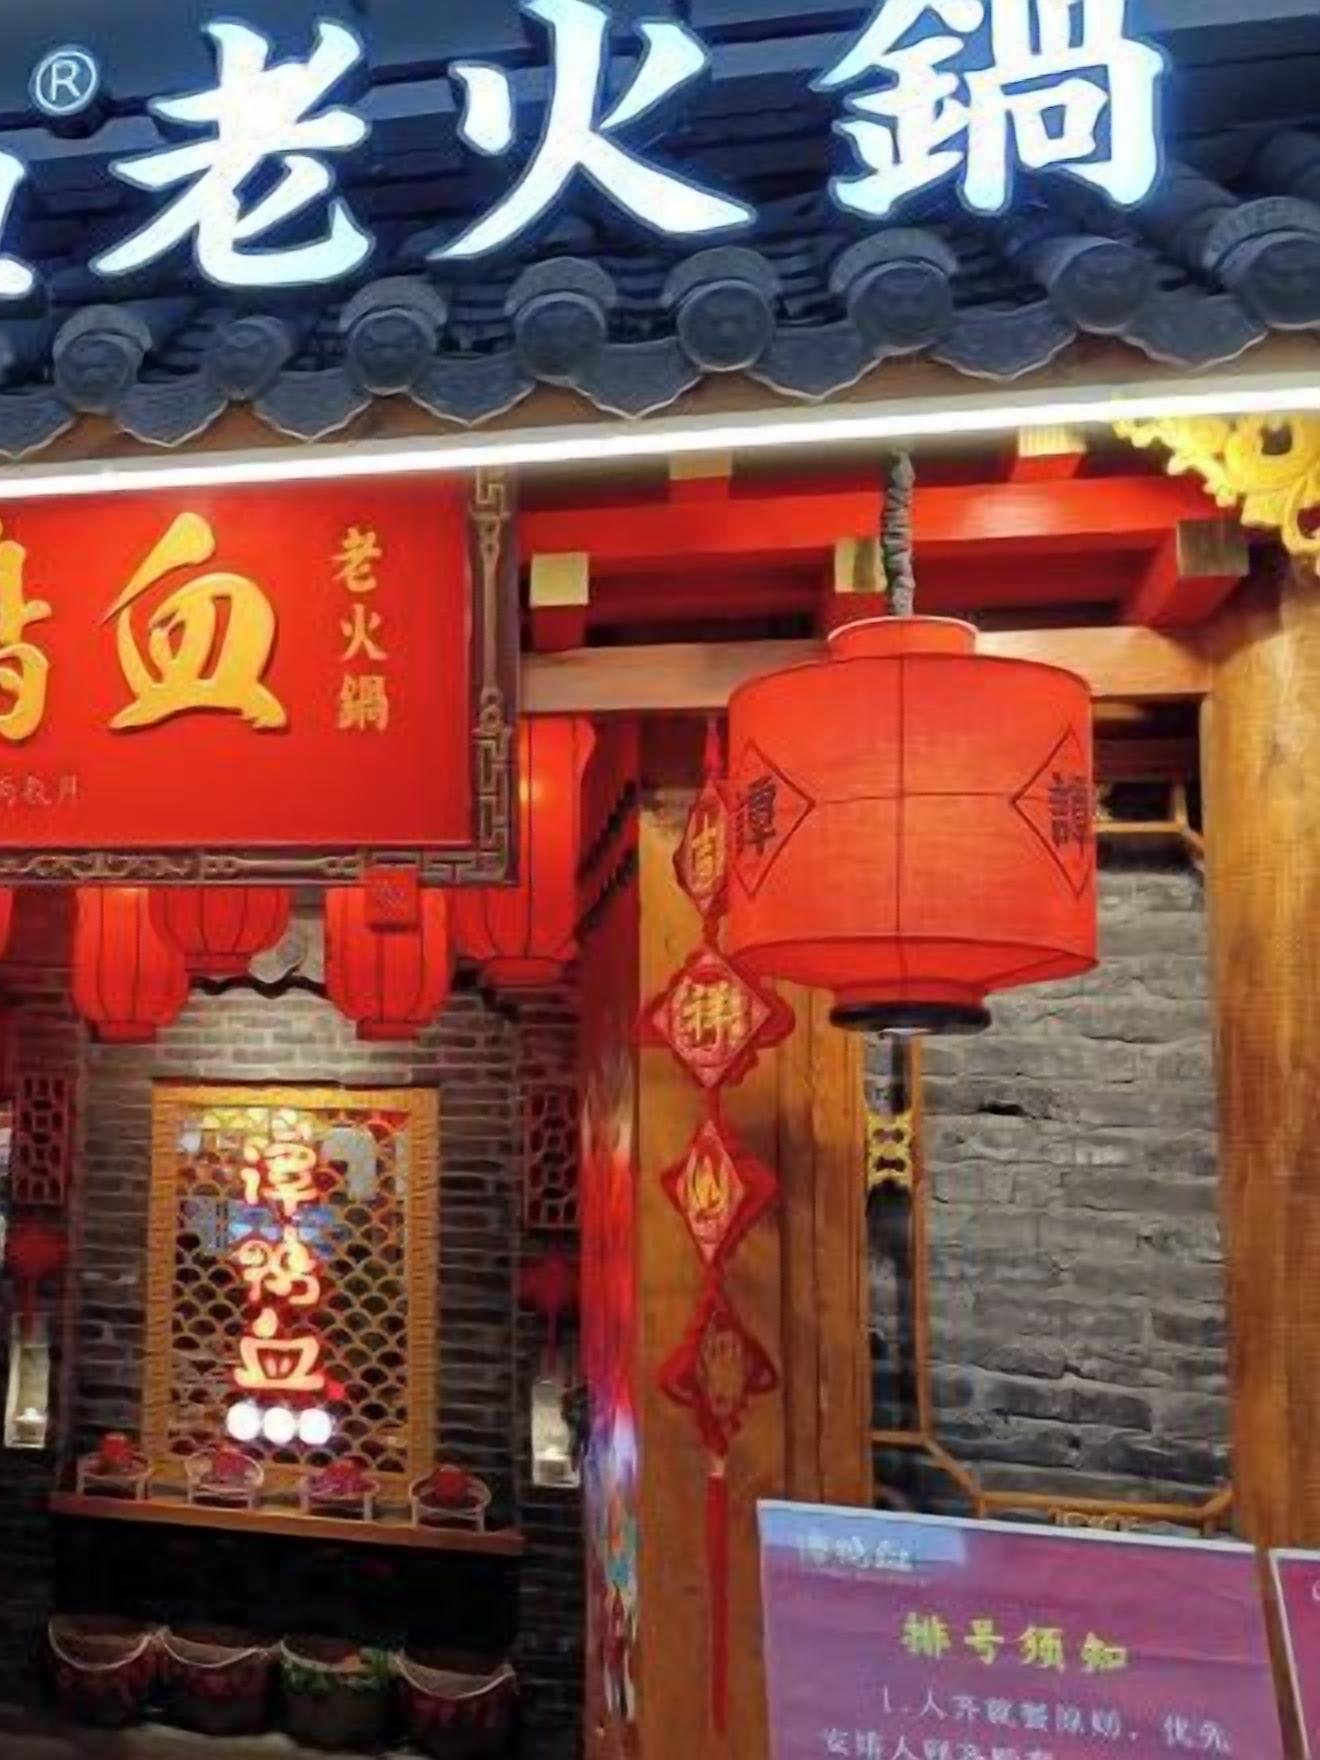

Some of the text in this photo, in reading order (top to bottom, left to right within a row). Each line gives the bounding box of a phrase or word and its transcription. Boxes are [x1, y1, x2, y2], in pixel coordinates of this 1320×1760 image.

[331, 527, 388, 731] 老火鍋
[902, 1611, 1128, 1674] 排号须知
